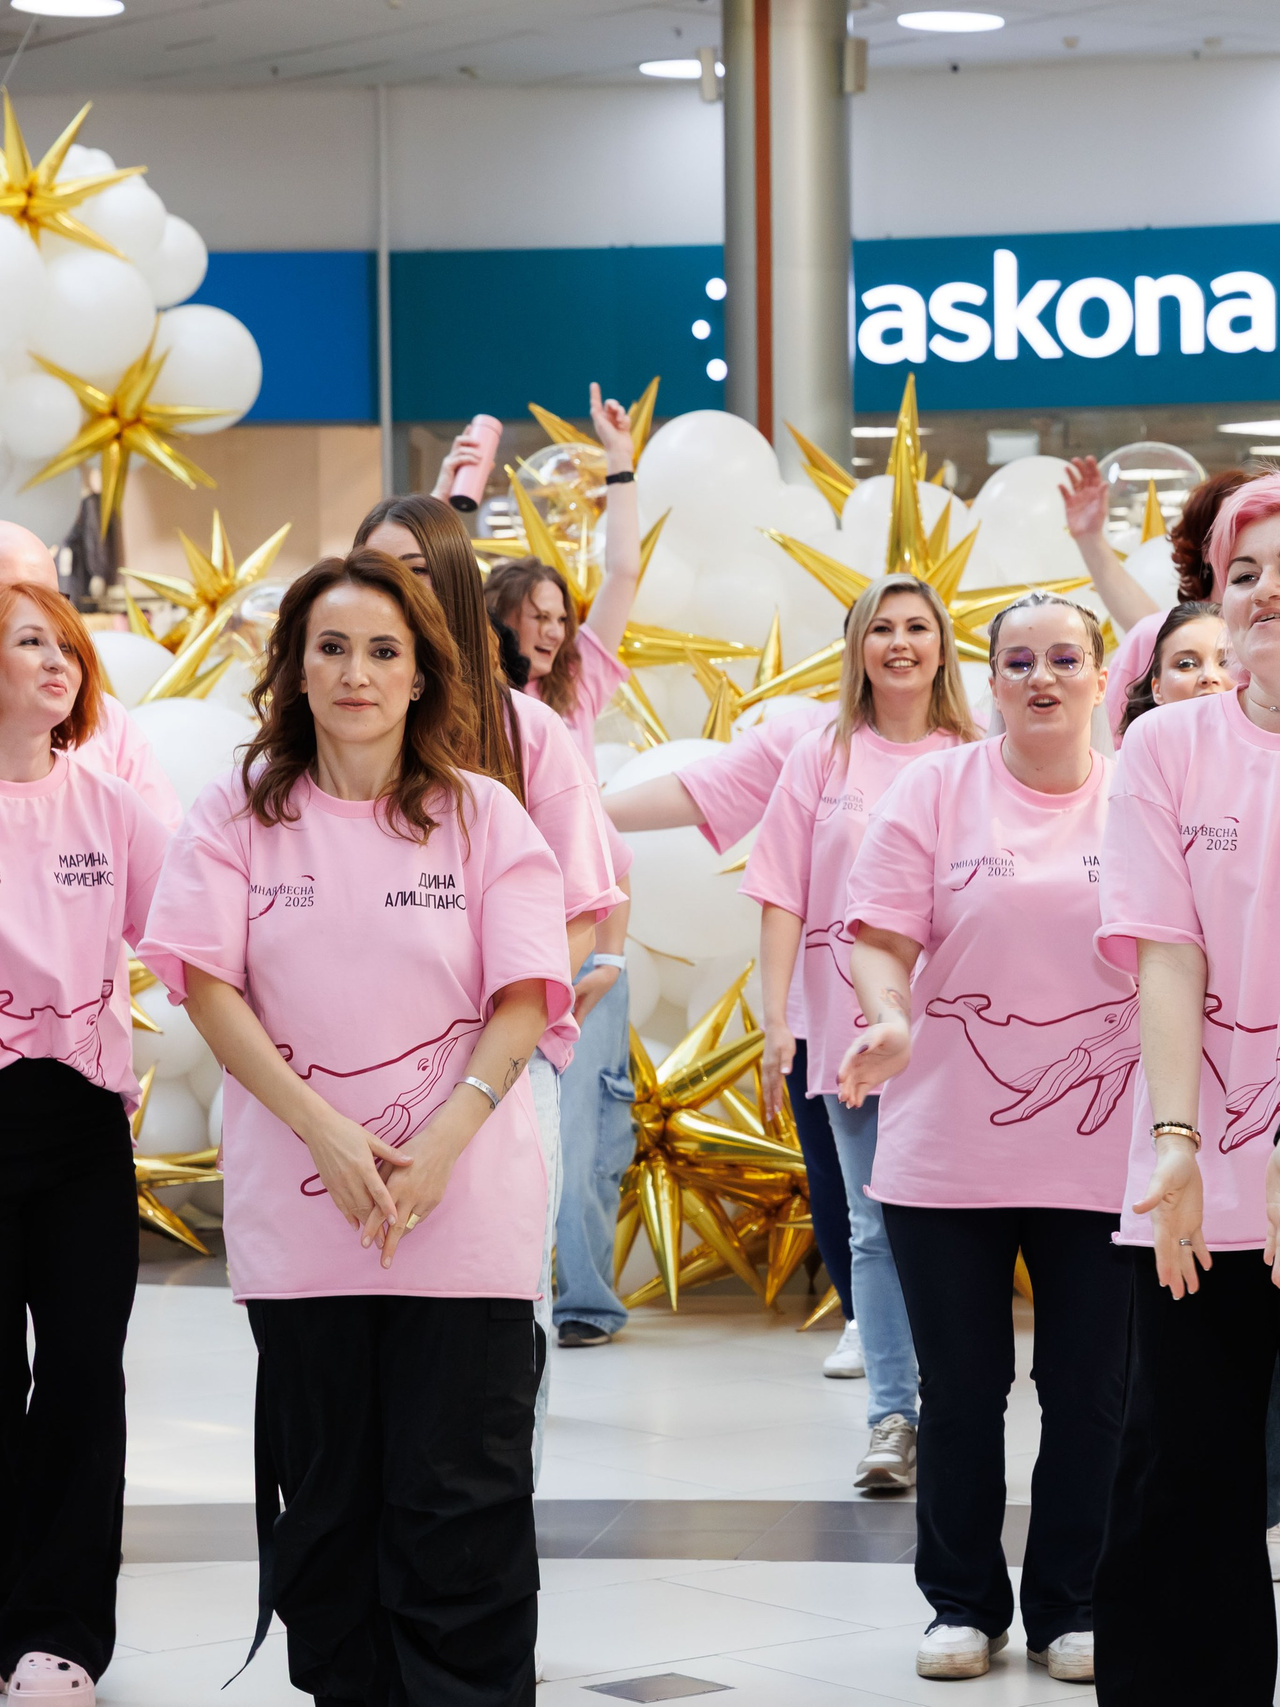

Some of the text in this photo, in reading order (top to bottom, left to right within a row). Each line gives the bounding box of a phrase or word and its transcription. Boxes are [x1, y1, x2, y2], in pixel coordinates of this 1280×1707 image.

[858, 249, 1276, 364] askona
[1200, 826, 1238, 838] ВЕСНА
[1206, 839, 1238, 851] 2025
[59, 852, 108, 868] МАРИНА
[950, 857, 1015, 871] УМНАЯ ВЕСНА
[1082, 855, 1100, 866] НА
[987, 867, 1015, 877] 2025
[54, 871, 114, 887] КИРИЕНКО
[418, 872, 456, 889] ДИНА
[249, 884, 314, 896] МНАЯ ВЕСНА
[285, 896, 314, 907] 2025
[385, 891, 466, 910] АЛИШПАНО
